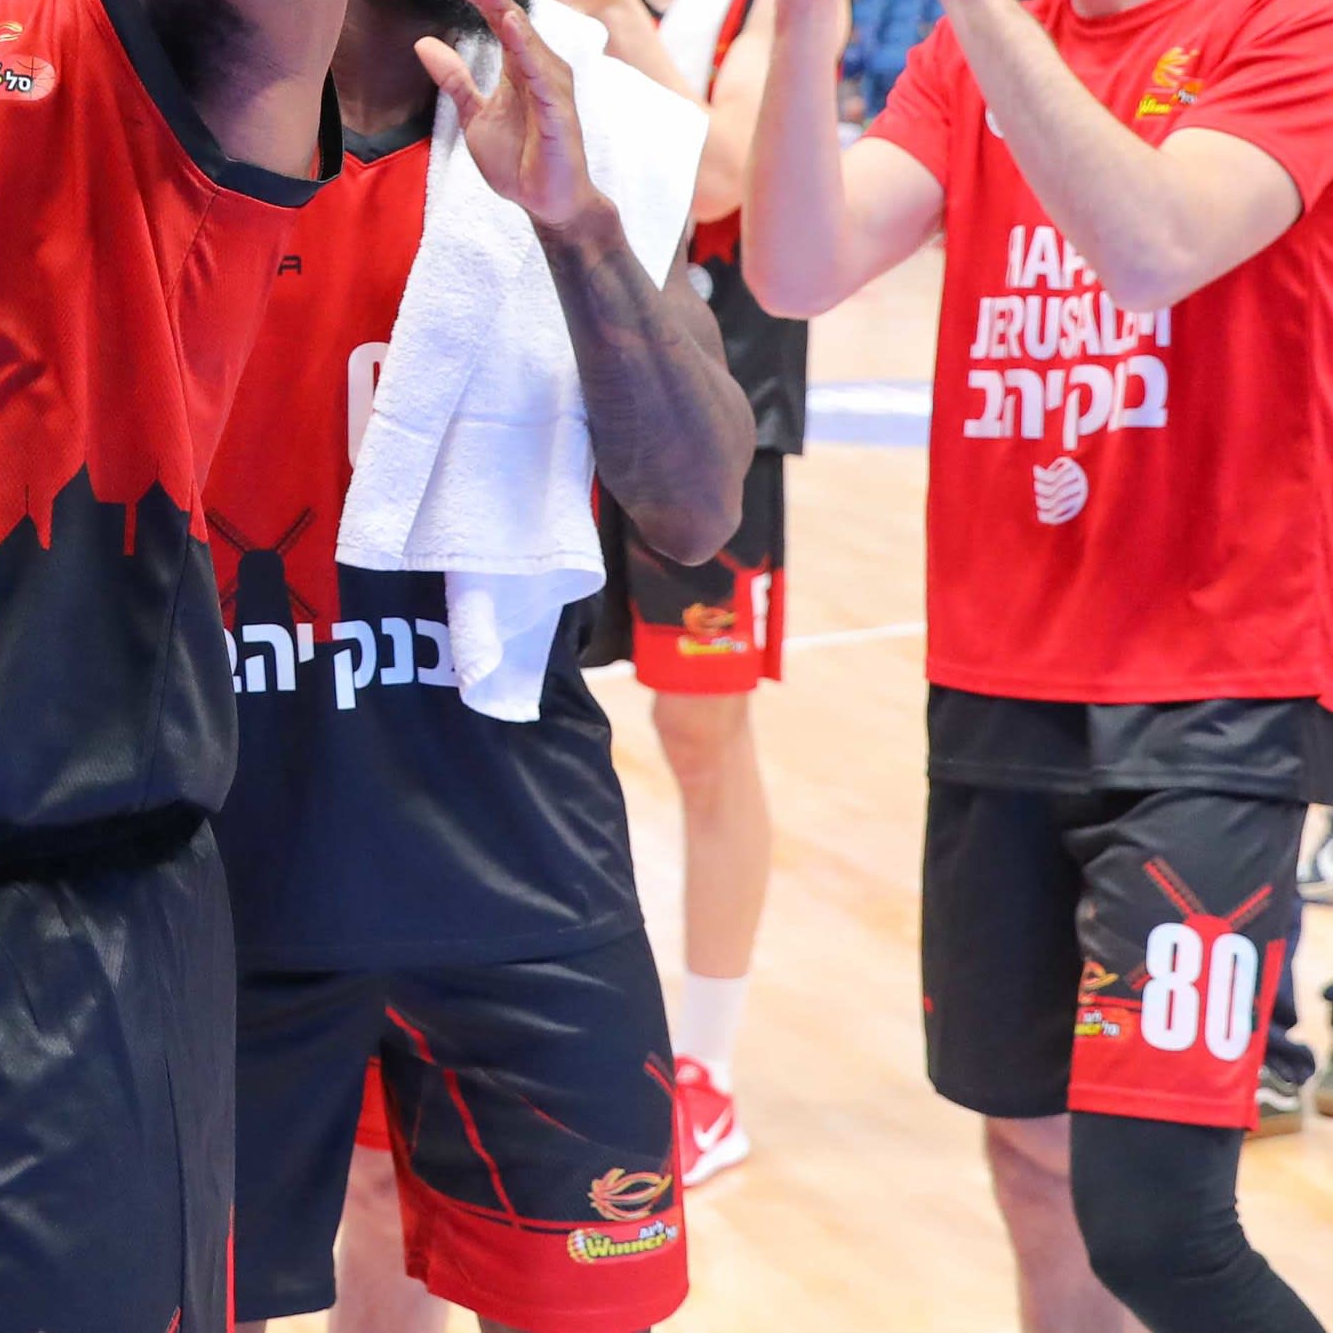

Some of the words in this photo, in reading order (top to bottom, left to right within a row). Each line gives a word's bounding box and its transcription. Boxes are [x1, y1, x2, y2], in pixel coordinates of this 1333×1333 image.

[4, 71, 32, 92] סל
[963, 367, 1066, 440] יהב
[331, 616, 459, 710] בנק
[1140, 922, 1259, 1062] 80
[585, 1233, 668, 1259] Winner
